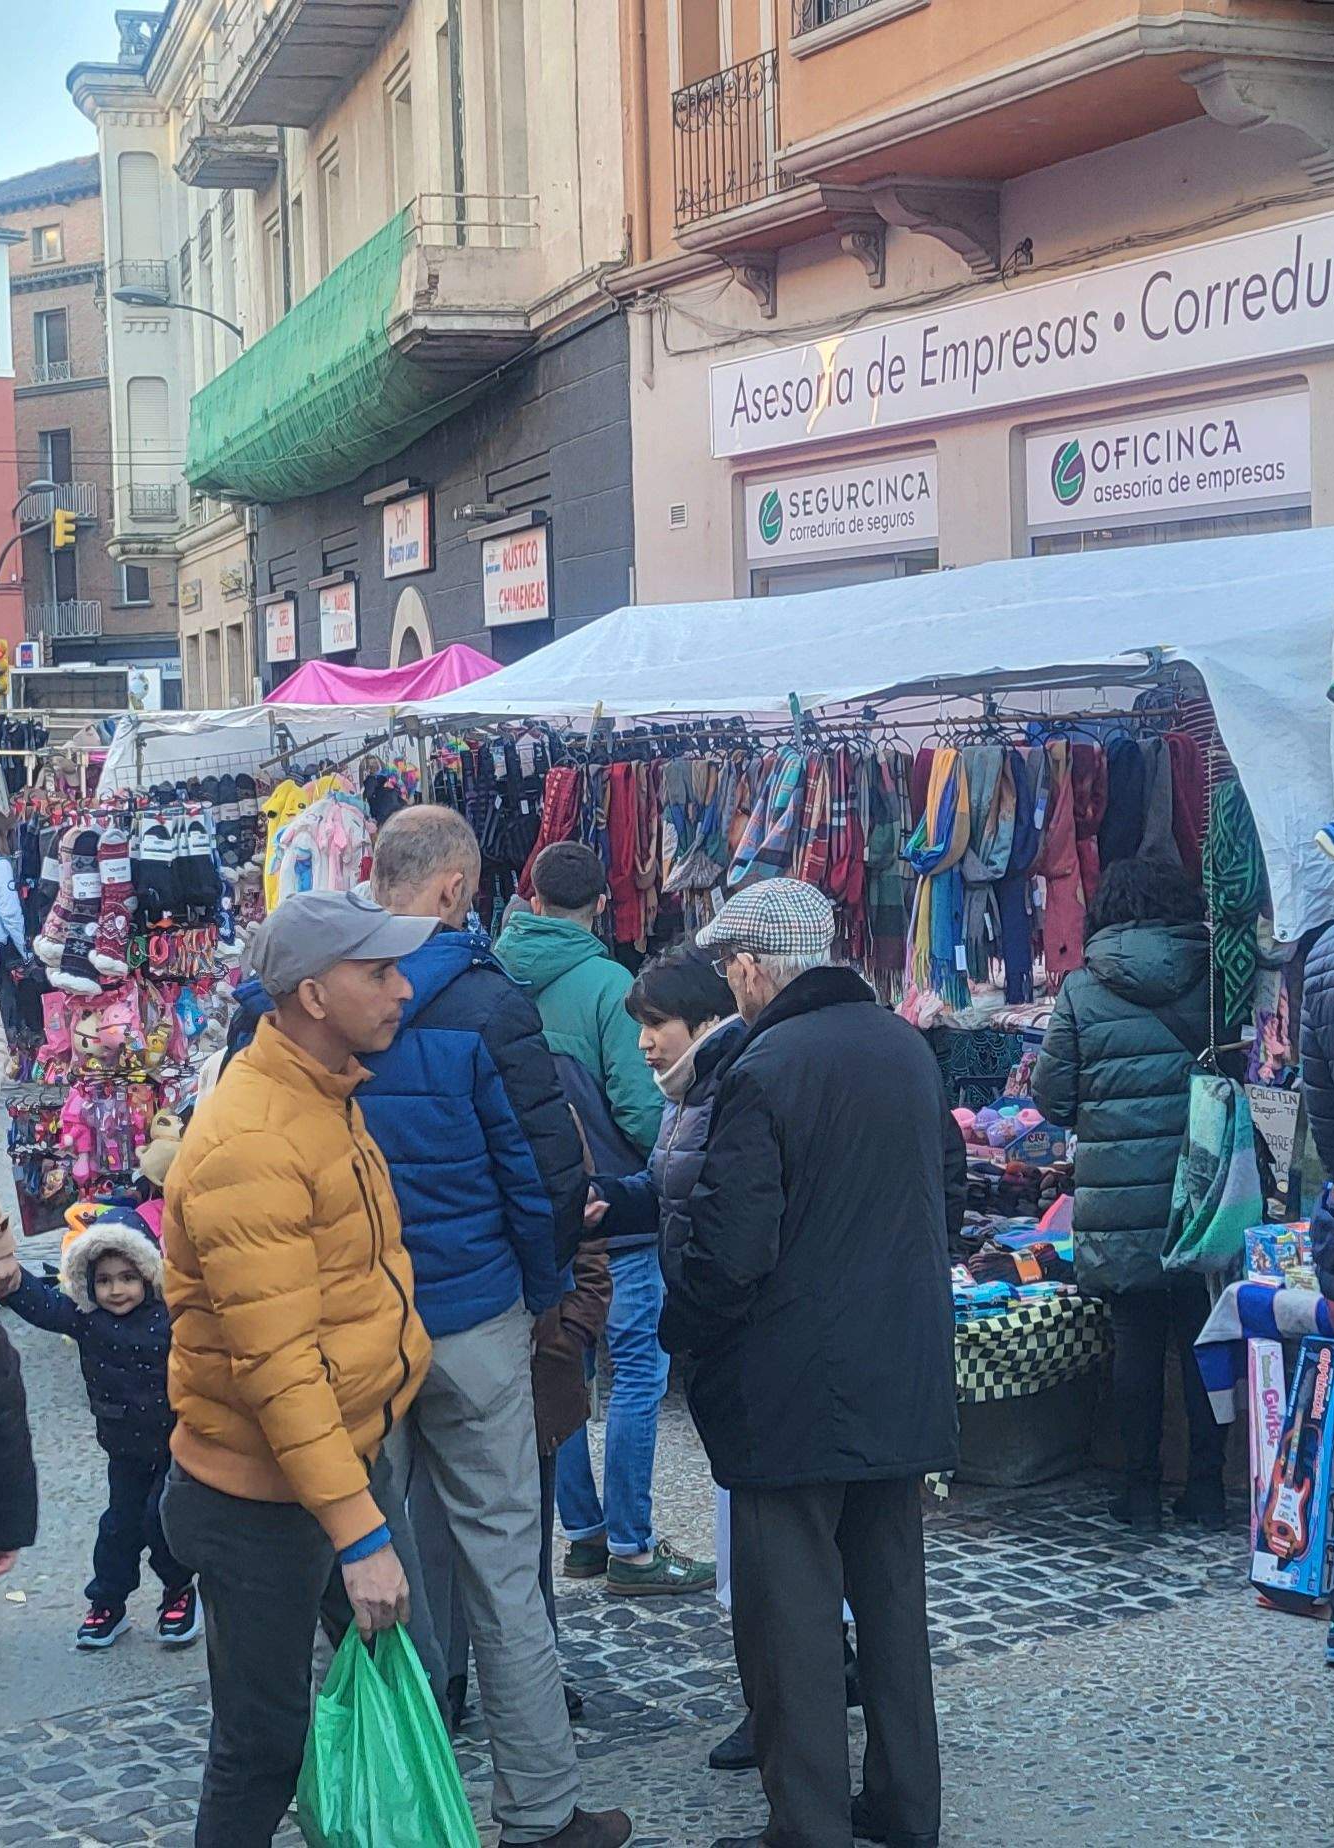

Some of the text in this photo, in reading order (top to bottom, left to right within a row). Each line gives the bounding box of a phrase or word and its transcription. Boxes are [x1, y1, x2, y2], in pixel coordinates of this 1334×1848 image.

[866, 336, 906, 400] de
[920, 308, 1100, 395] Empresas
[1091, 420, 1242, 473] OFICINCA
[789, 471, 931, 518] SEGURCINCA
[1094, 461, 1285, 503] asesoría de empresas
[848, 515, 864, 533] de
[867, 510, 915, 534] seguros
[503, 539, 538, 573] RÚSTICO
[499, 580, 546, 615] CHIMENEAS
